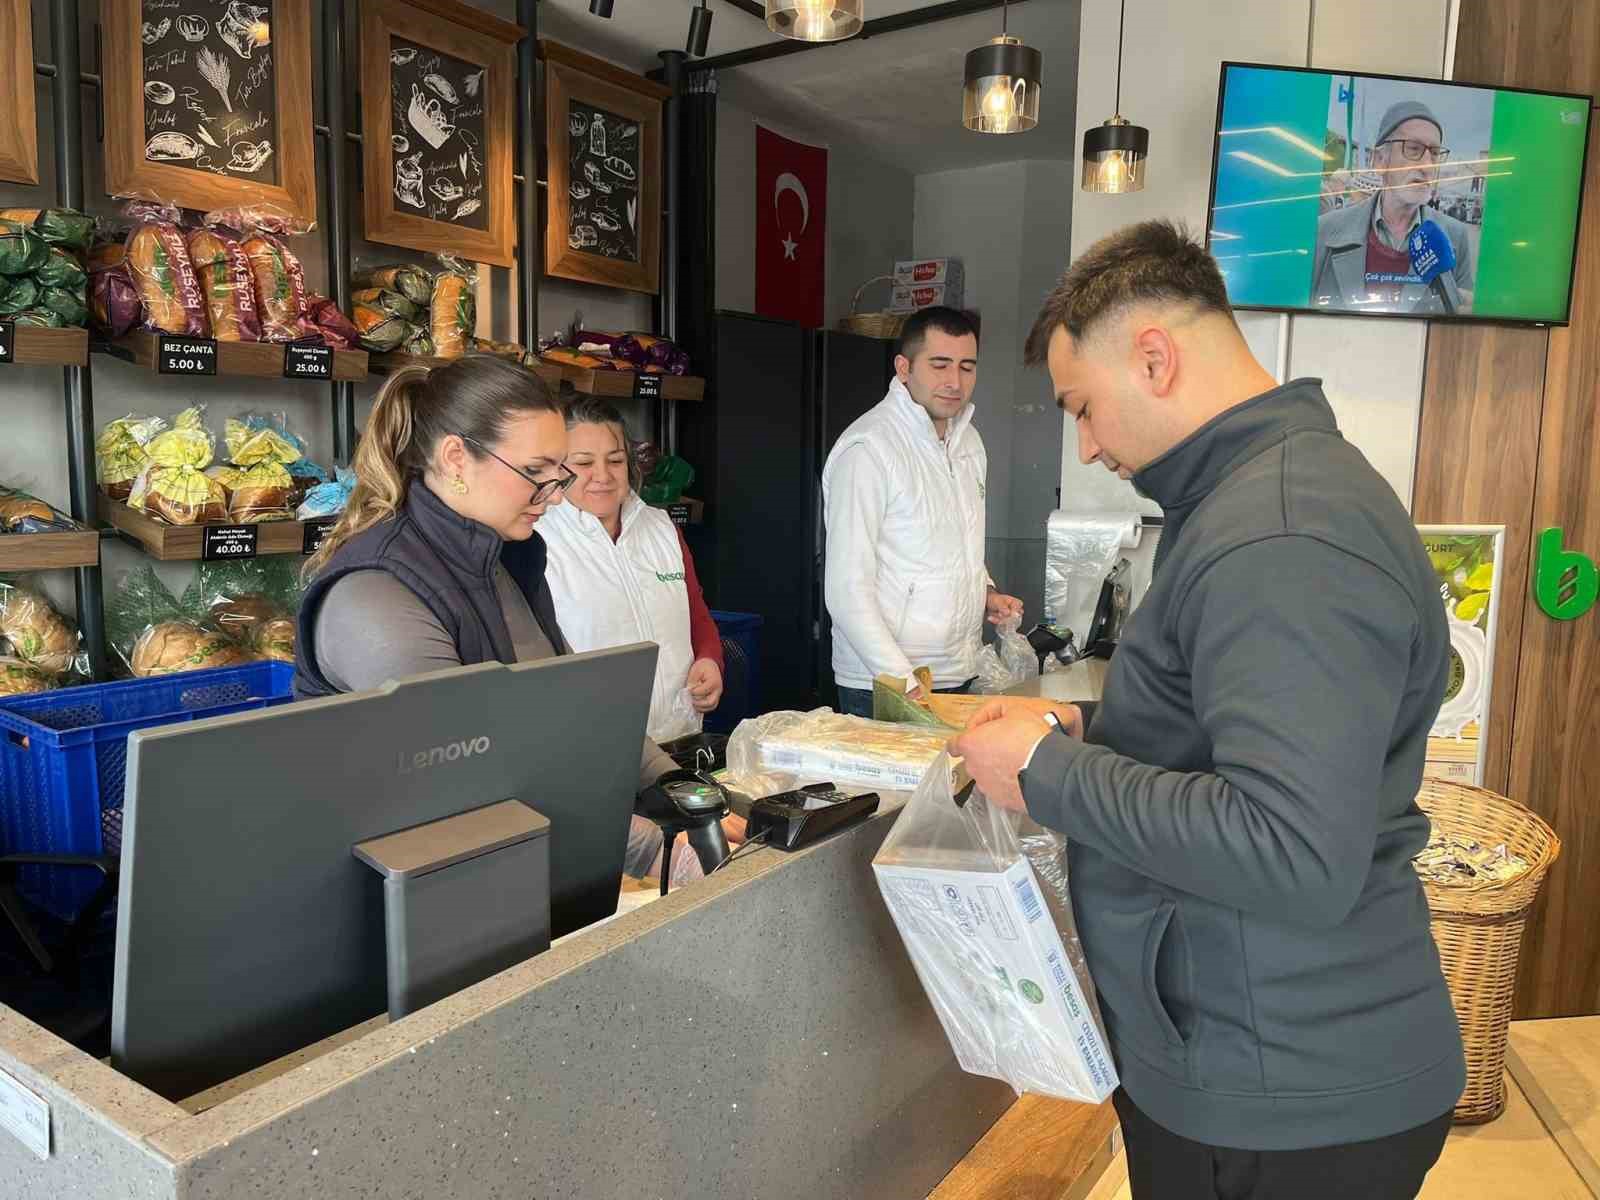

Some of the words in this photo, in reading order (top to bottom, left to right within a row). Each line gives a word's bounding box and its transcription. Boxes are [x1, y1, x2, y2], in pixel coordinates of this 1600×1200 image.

[164, 343, 182, 353] BEZ
[183, 344, 213, 355] ÇANTA
[169, 359, 194, 370] 5.00
[296, 363, 319, 373] 25.00
[215, 545, 243, 554] 40.00
[391, 735, 490, 776] Lenovo
